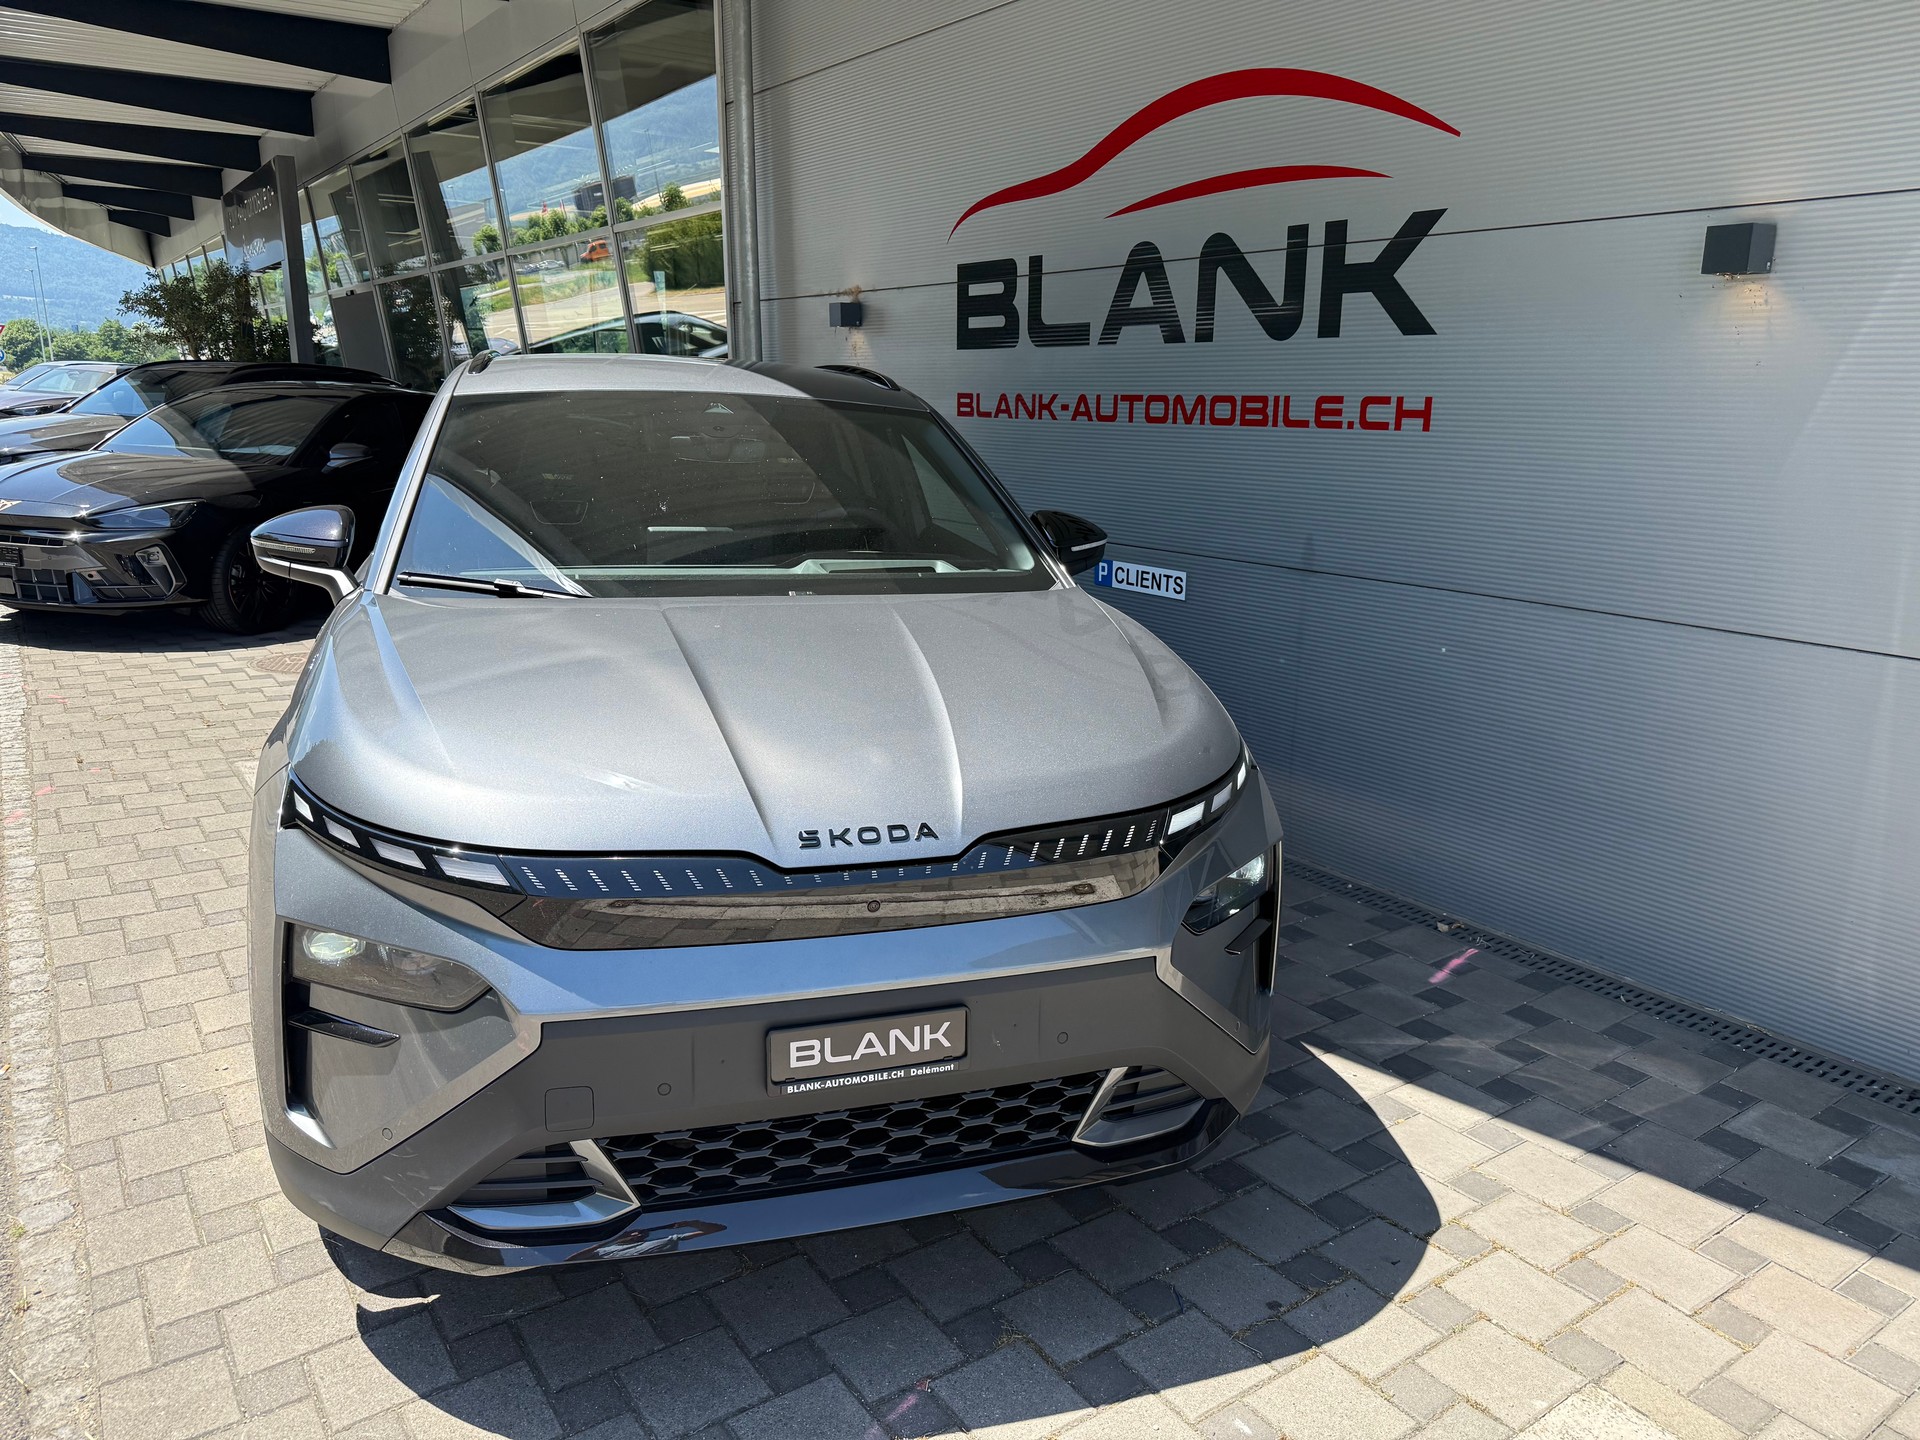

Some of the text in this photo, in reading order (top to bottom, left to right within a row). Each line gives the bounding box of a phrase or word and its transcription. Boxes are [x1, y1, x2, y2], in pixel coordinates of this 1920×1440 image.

[956, 207, 1449, 350] BLANK
[956, 392, 1433, 433] BLANK-AUTOMOBILE.CH
[1098, 562, 1184, 595] P CLIENTS
[789, 1021, 951, 1068] BLANK
[786, 1063, 955, 1094] BLANK-AUTOMOBILE.CH Delémont
